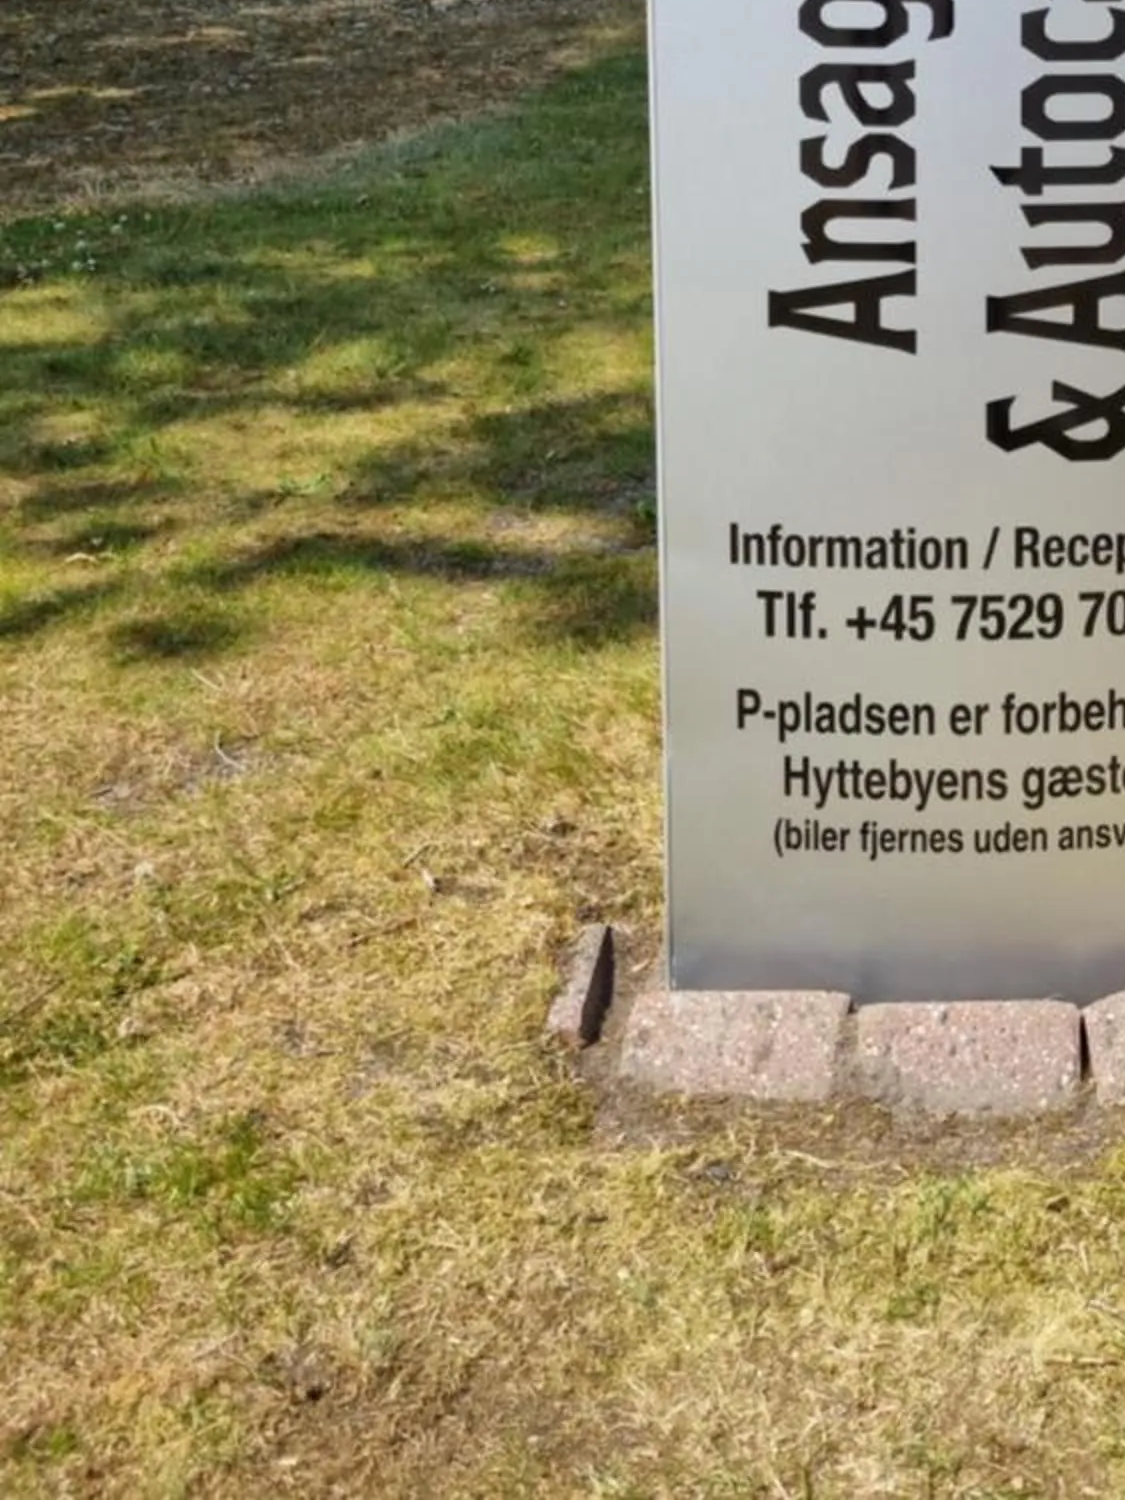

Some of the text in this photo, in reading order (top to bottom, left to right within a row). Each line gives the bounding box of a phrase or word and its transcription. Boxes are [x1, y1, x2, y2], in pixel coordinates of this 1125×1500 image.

[729, 522, 969, 571] Information
[982, 525, 1001, 570] /
[756, 589, 828, 640] Tlf.
[845, 593, 936, 642] +45
[950, 592, 1064, 641] 7529
[736, 687, 936, 744] P-pladsen
[949, 703, 990, 737] er
[783, 755, 1009, 813] Hyttebyens
[773, 818, 851, 858] (biler
[859, 820, 964, 862] fjernes
[973, 821, 1048, 854] uden
